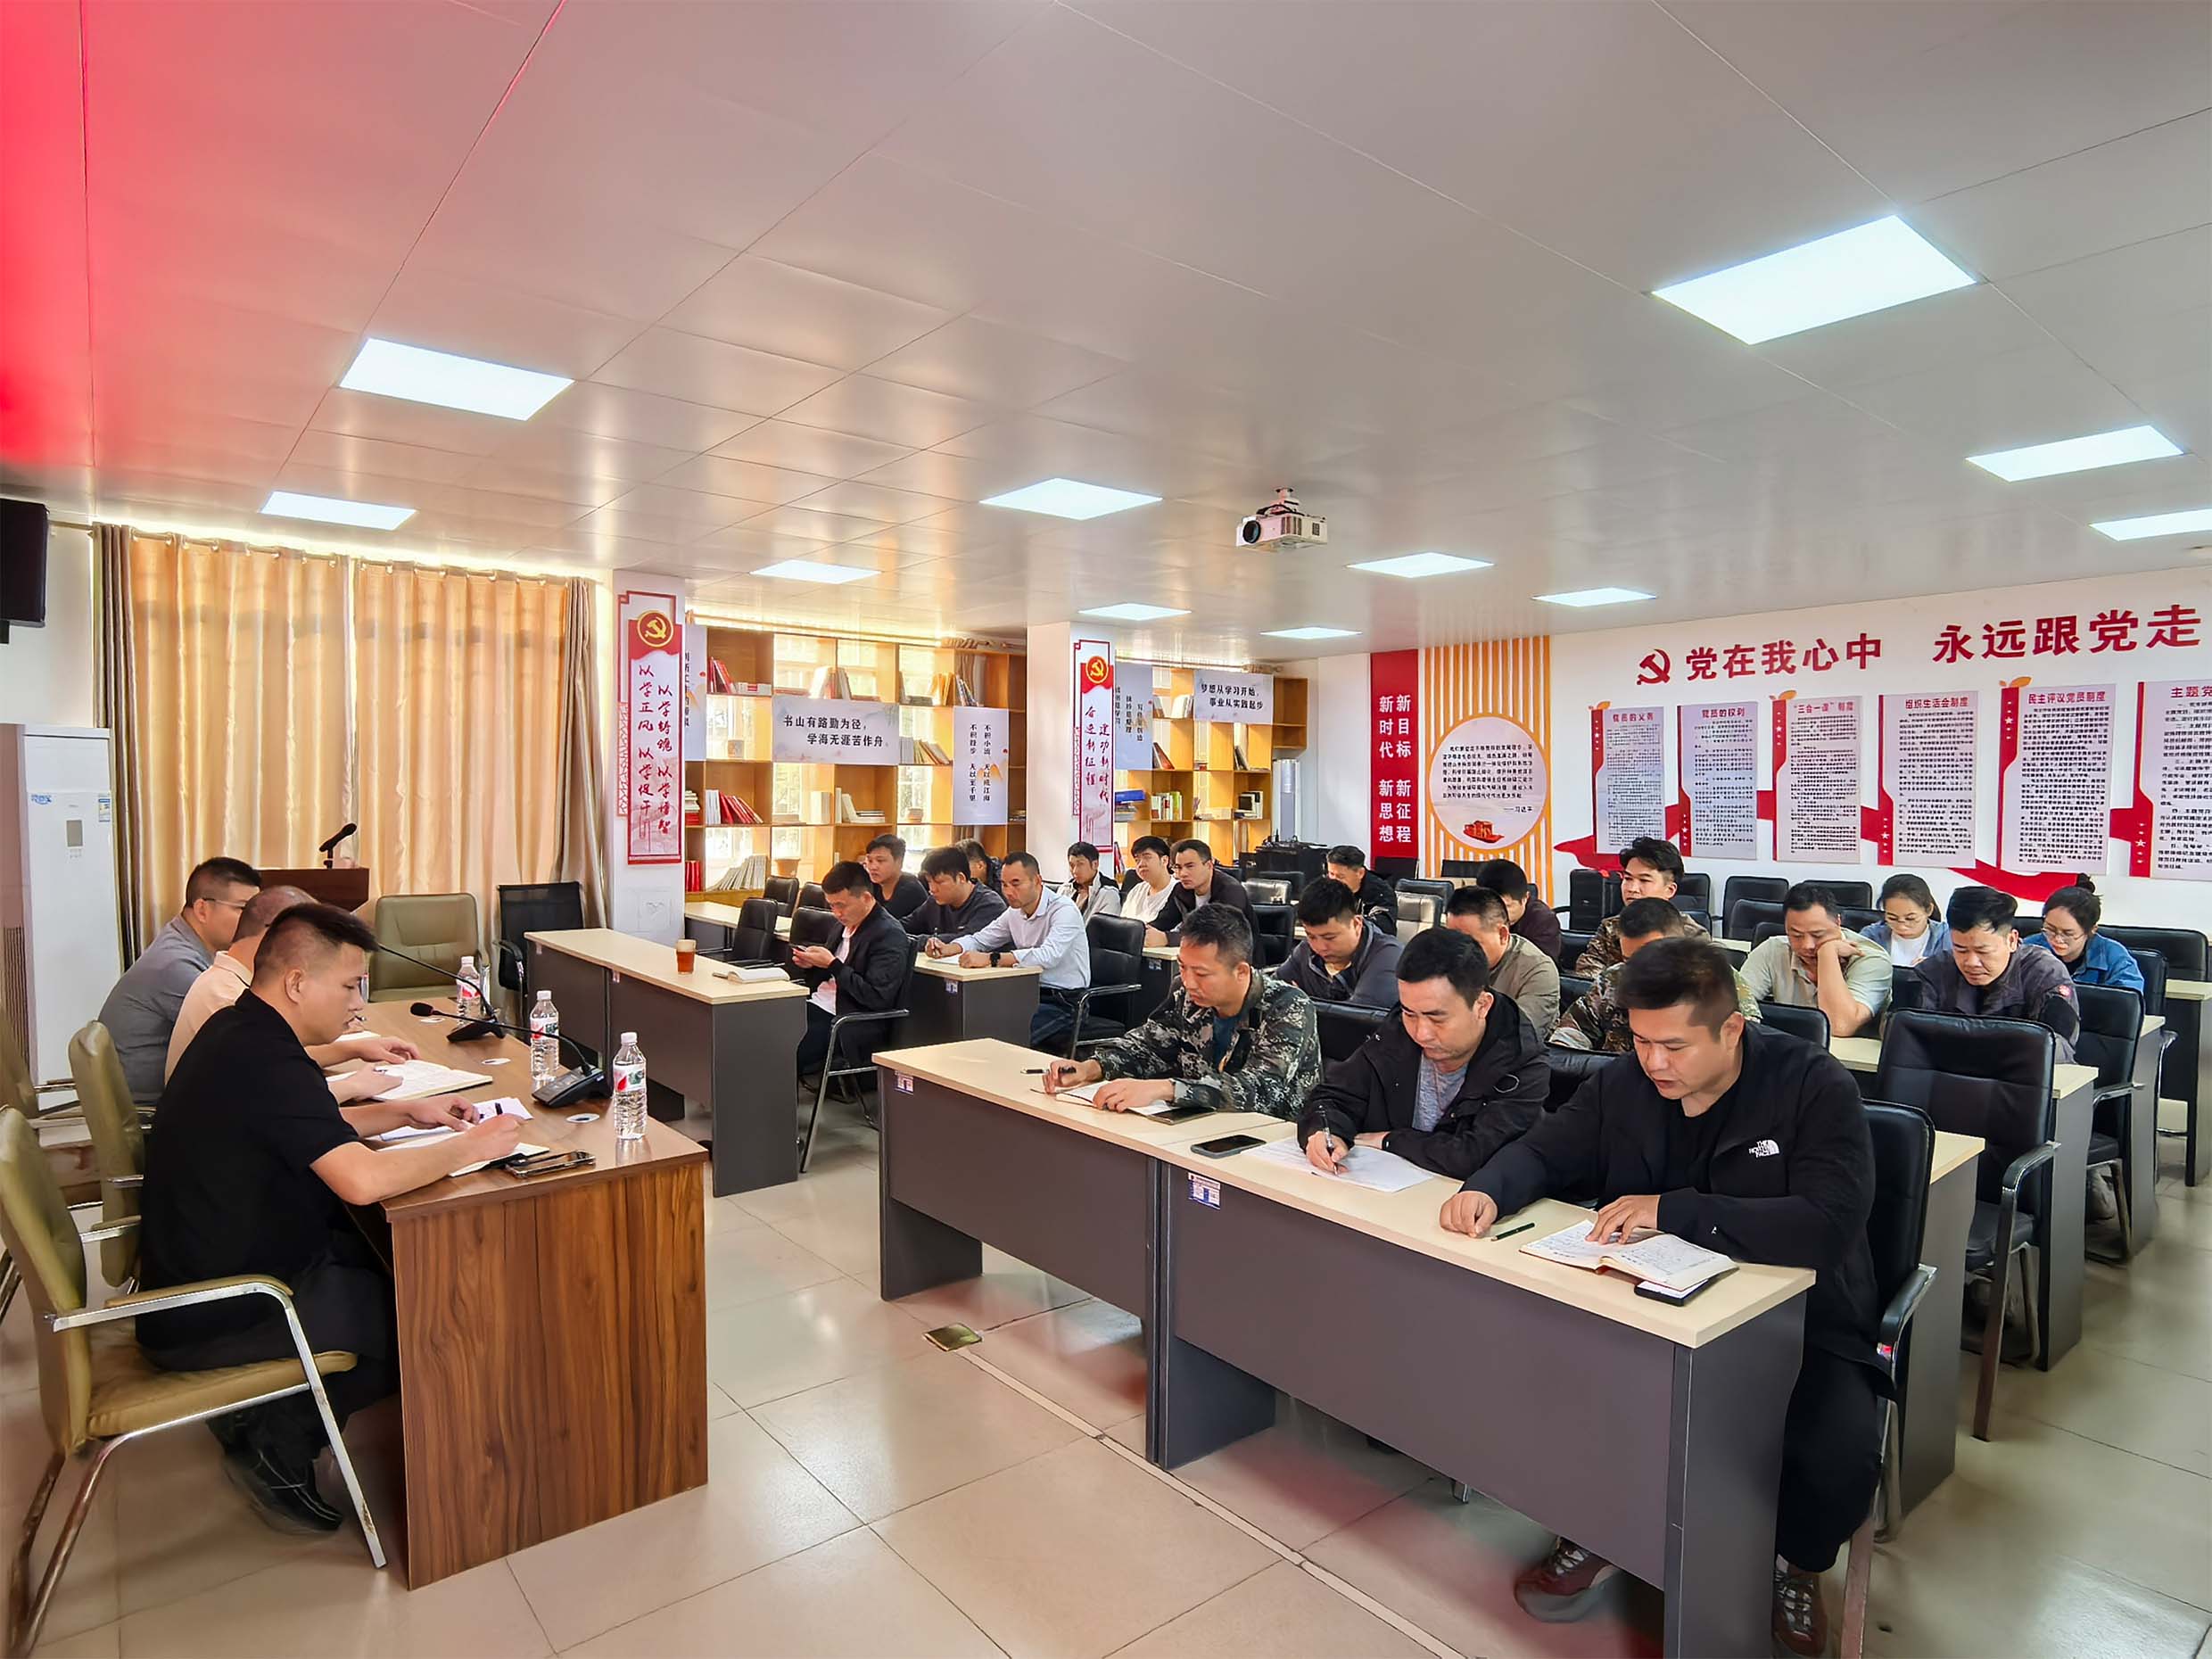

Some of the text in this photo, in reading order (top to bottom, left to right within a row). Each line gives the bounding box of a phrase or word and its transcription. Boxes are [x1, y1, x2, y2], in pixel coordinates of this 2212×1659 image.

[1685, 604, 2201, 681] 党在我心中 永远跟党走
[1905, 697, 1969, 709] 组织生活会制度
[2028, 691, 2106, 705] 民主评议党员制度
[1379, 696, 1393, 843] 新时代 新思想
[1396, 695, 1411, 843] 新目标 新征程
